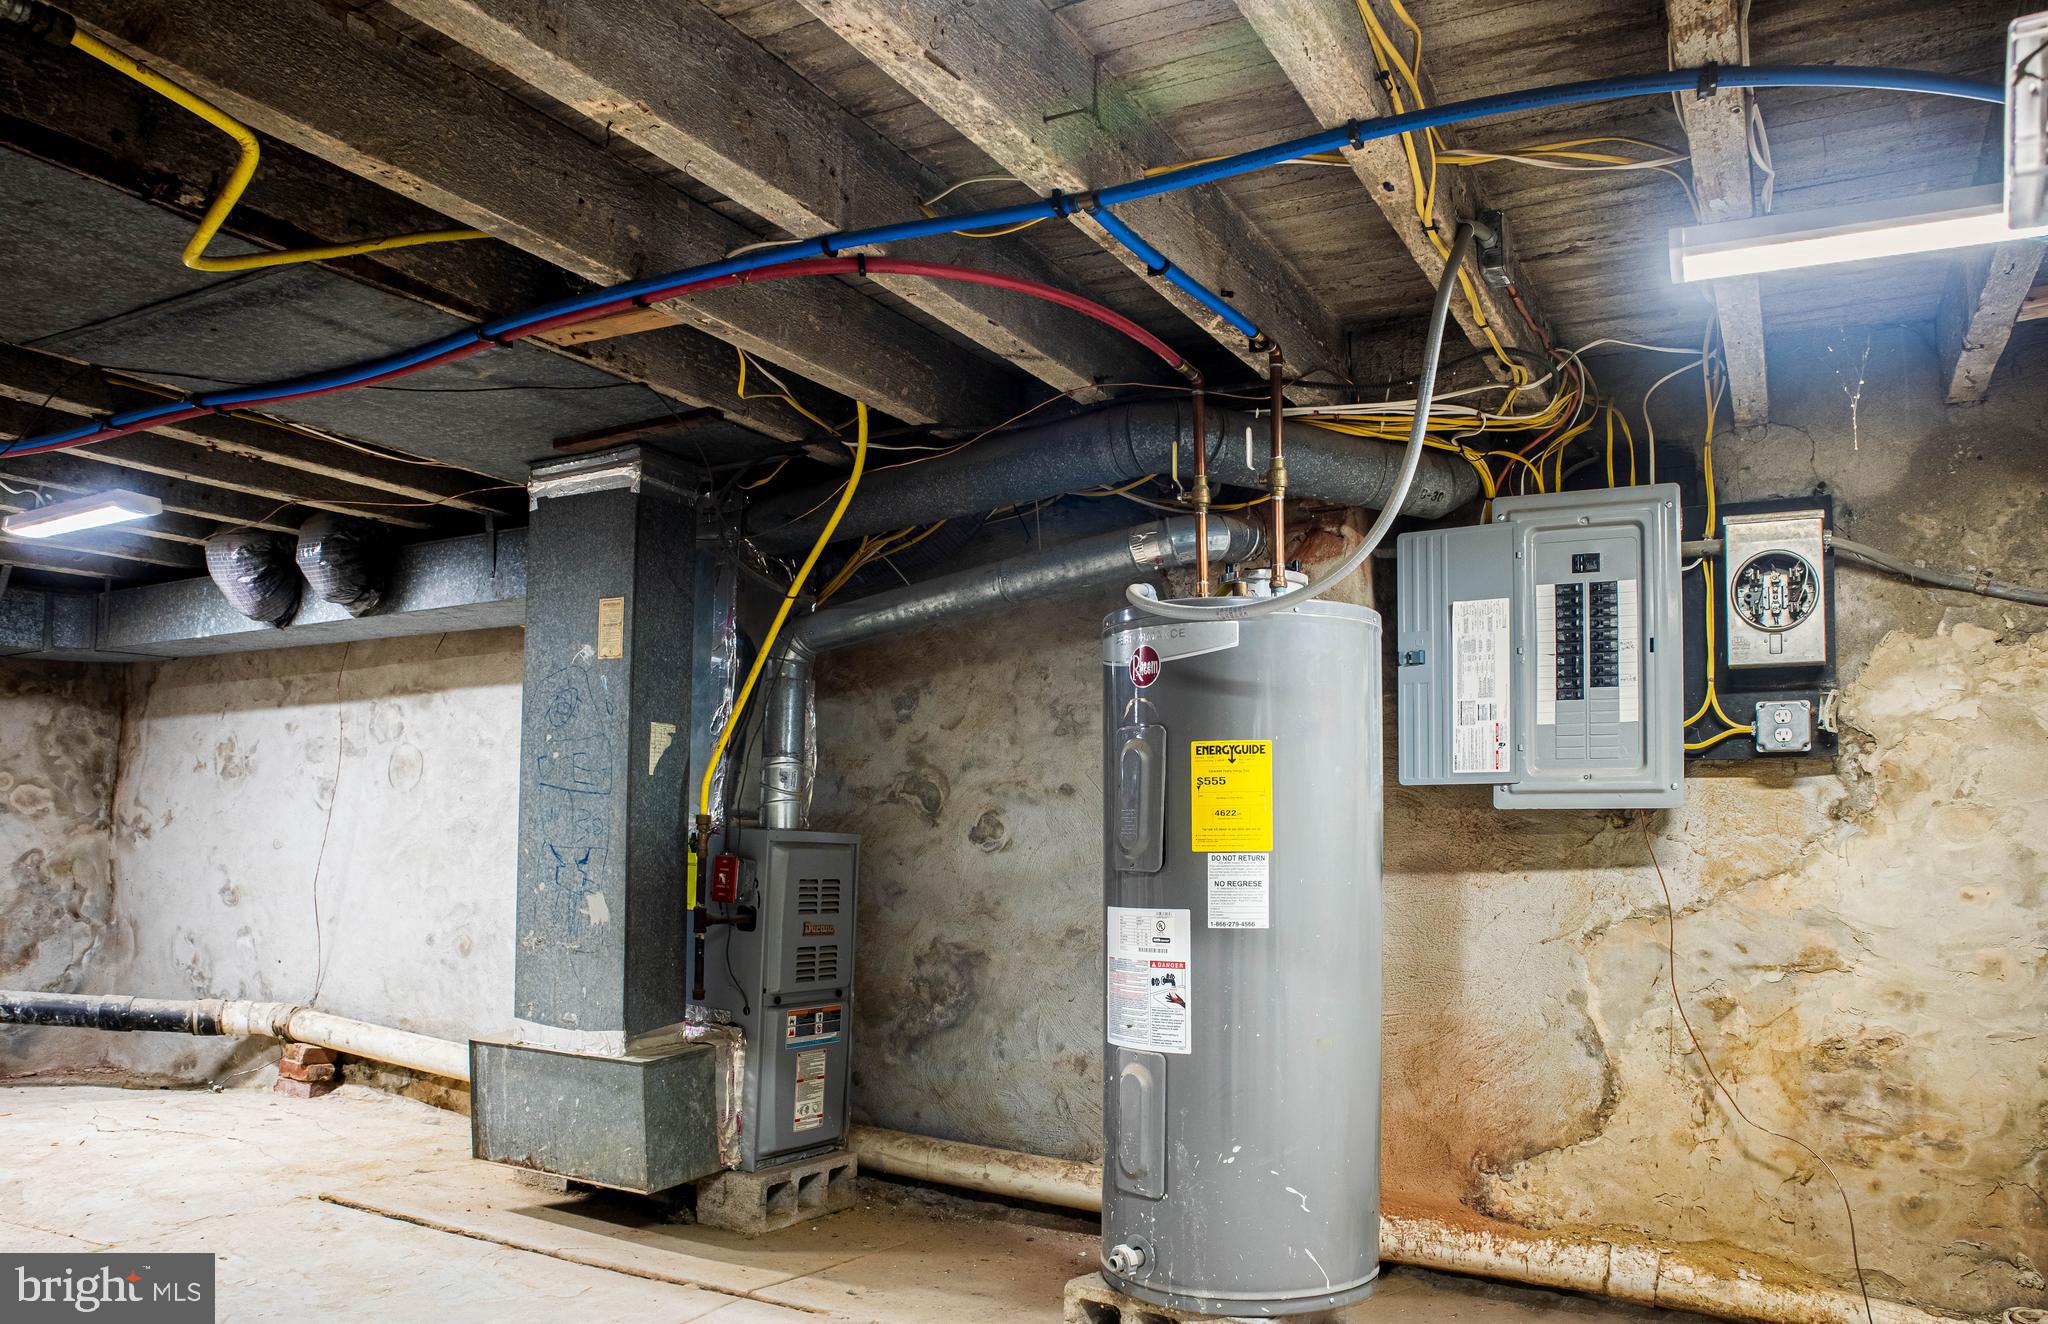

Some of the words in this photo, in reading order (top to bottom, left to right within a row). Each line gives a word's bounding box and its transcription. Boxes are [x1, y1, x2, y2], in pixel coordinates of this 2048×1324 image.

[1132, 655, 1158, 681] Rheem
[1196, 745, 1266, 758] ENERGYGUIDE
[1196, 777, 1226, 786] $555
